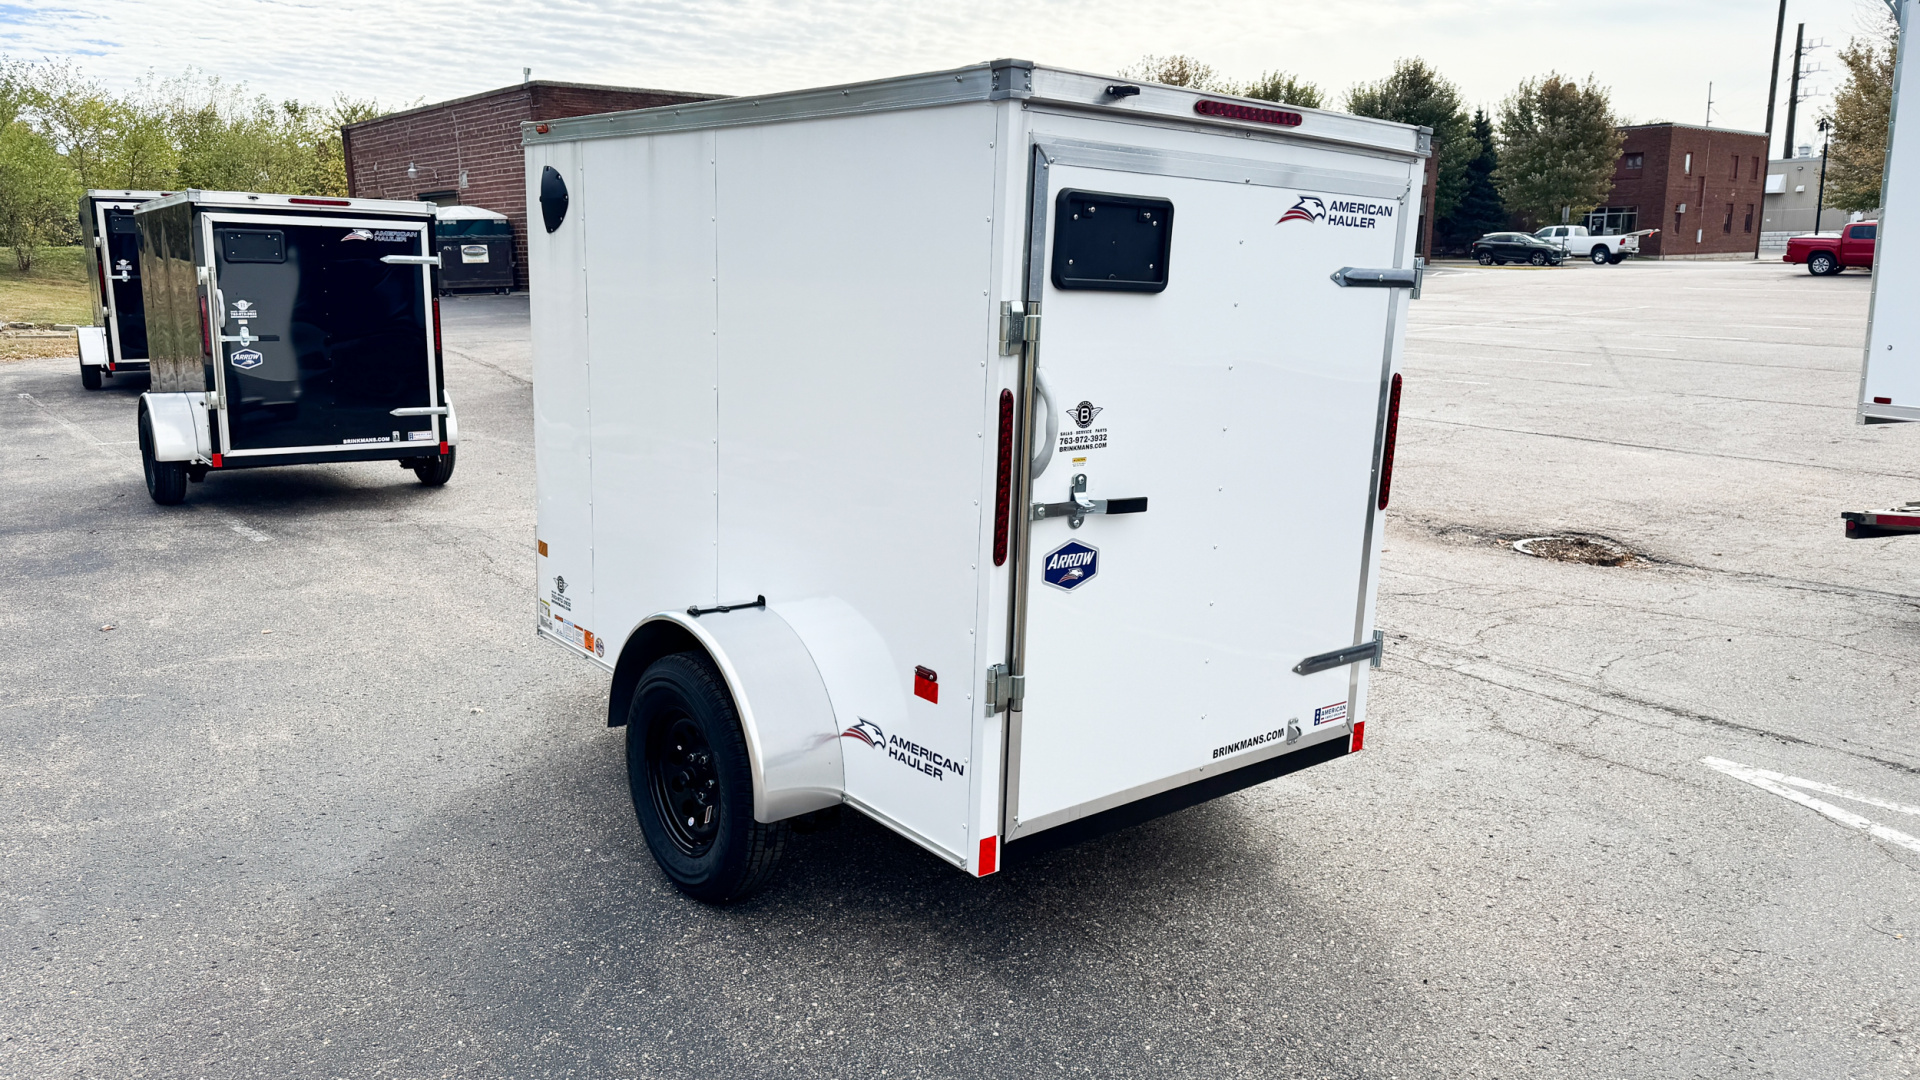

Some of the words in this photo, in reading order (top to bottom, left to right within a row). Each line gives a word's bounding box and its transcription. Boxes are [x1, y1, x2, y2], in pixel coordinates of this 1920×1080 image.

[1329, 200, 1393, 217] AMERICAN
[1328, 214, 1376, 229] HAULER
[234, 353, 260, 361] ARROW
[1080, 407, 1090, 422] B
[343, 436, 390, 444] BRINKMANS.COM
[1059, 434, 1108, 445] 763-972-3932
[1059, 442, 1107, 453] BRINKMANS.COM
[1046, 550, 1096, 571] ARROW
[1320, 704, 1347, 716] AMERICAN
[1212, 727, 1285, 759] BRINKMANS.COM
[889, 734, 965, 776] AMERICAN
[888, 746, 944, 781] HAULER
